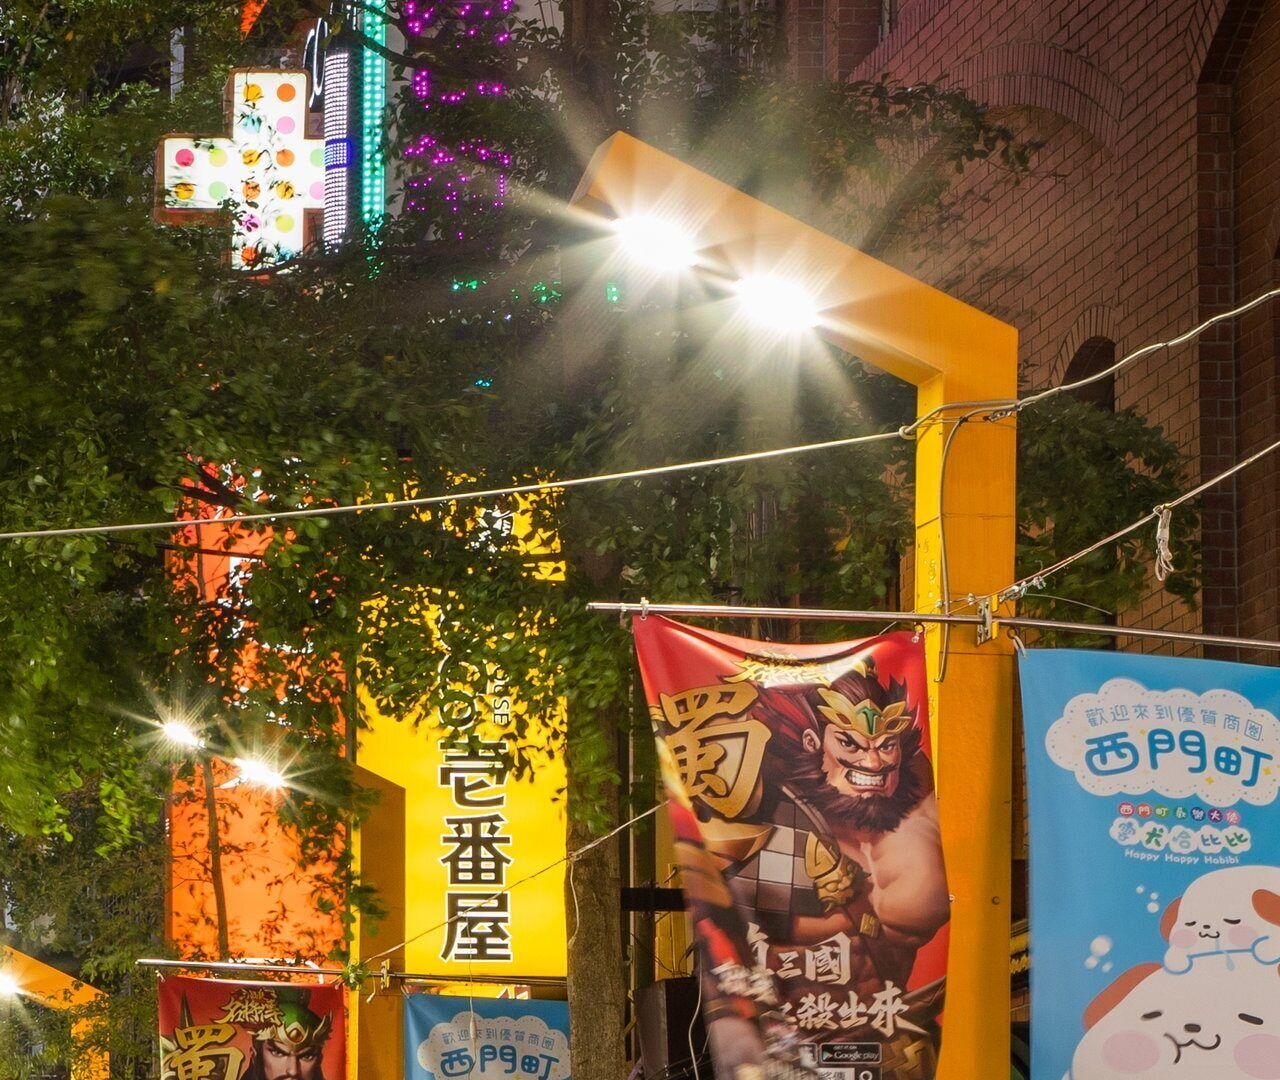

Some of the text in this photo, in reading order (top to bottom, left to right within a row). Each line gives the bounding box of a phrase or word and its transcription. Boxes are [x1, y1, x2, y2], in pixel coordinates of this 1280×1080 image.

[1085, 704, 1263, 742] 歡迎來到優質商圈
[660, 683, 774, 819] 蜀
[1085, 728, 1274, 787] 西門町
[1125, 850, 1239, 865] Happy Happy Habibi
[834, 1051, 879, 1062] Google play
